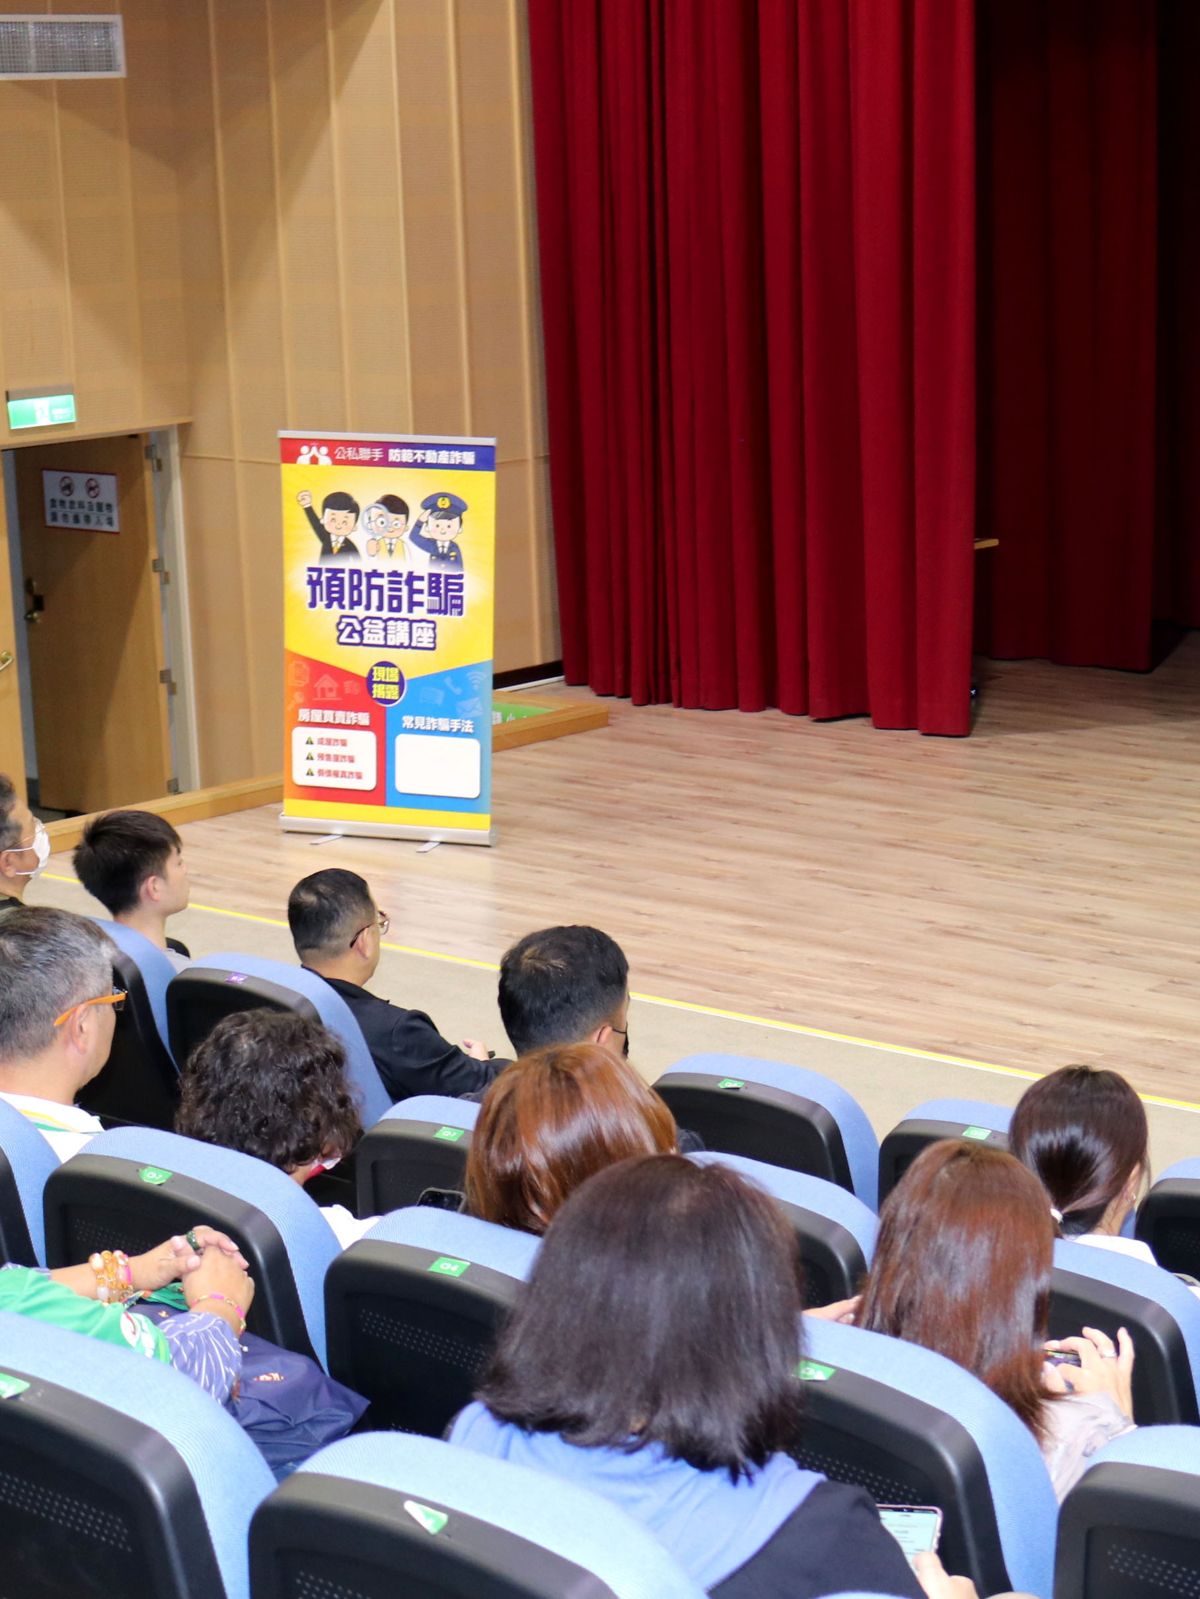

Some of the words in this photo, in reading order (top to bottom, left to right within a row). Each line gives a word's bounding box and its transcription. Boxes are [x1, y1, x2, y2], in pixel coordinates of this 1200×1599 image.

[334, 446, 384, 462] 公私聯手
[388, 448, 476, 466] 防範不動產詐騙
[306, 567, 464, 616] 預防詐騙
[337, 616, 436, 650] 公益講座
[298, 708, 370, 726] 房屋買賣詐騙
[402, 715, 474, 733] 常見詐騙手法
